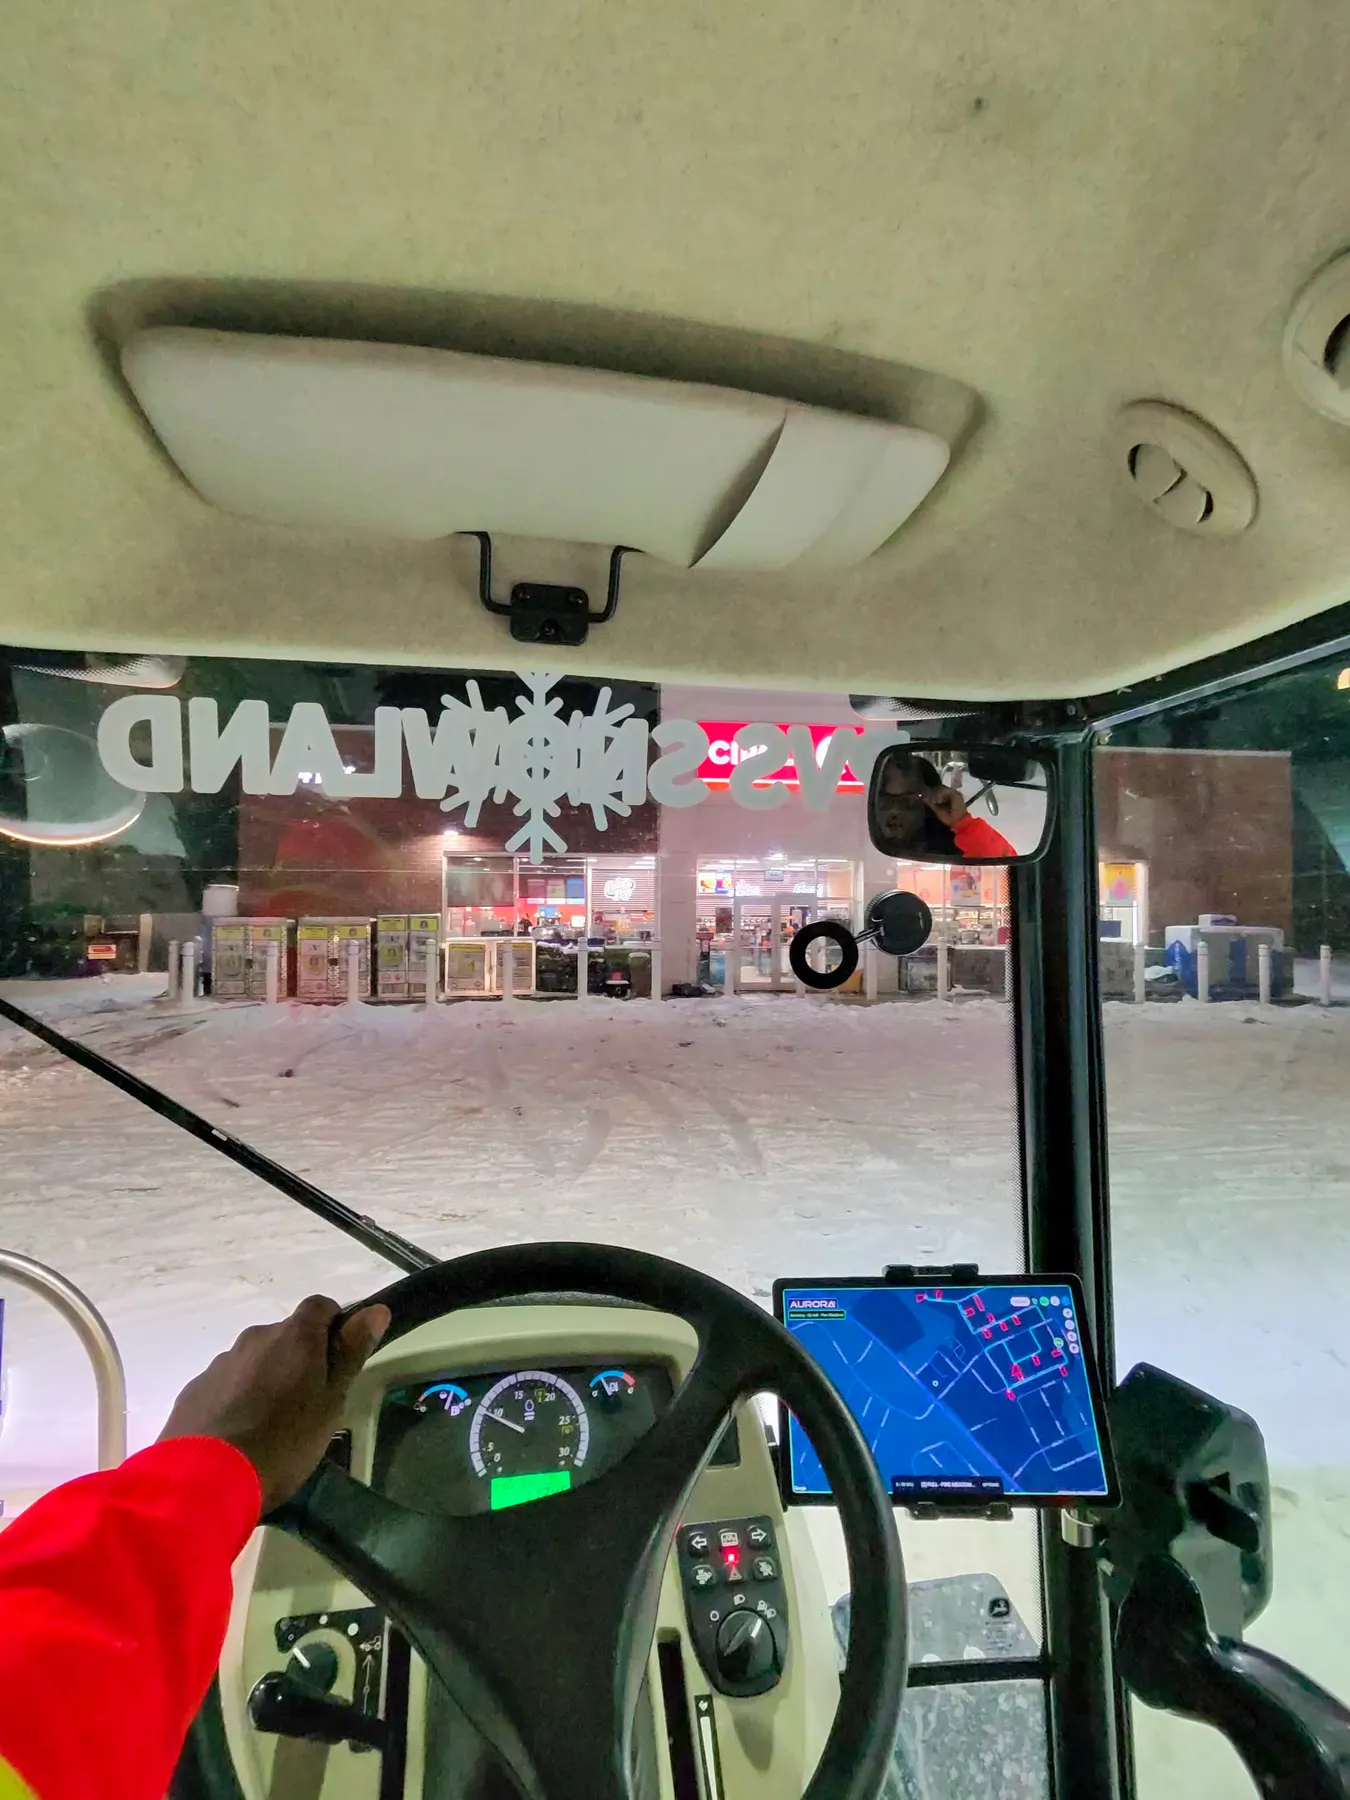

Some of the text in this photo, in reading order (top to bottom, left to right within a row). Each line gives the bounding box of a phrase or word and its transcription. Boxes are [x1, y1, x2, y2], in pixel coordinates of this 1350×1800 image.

[790, 1300, 836, 1309] AURORA
[514, 1390, 524, 1400] 15
[544, 1392, 556, 1402] 20
[493, 1407, 504, 1417] 10
[558, 1415, 571, 1426] 25
[486, 1441, 494, 1452] 5
[558, 1446, 570, 1458] 30
[493, 1452, 501, 1463] 0
